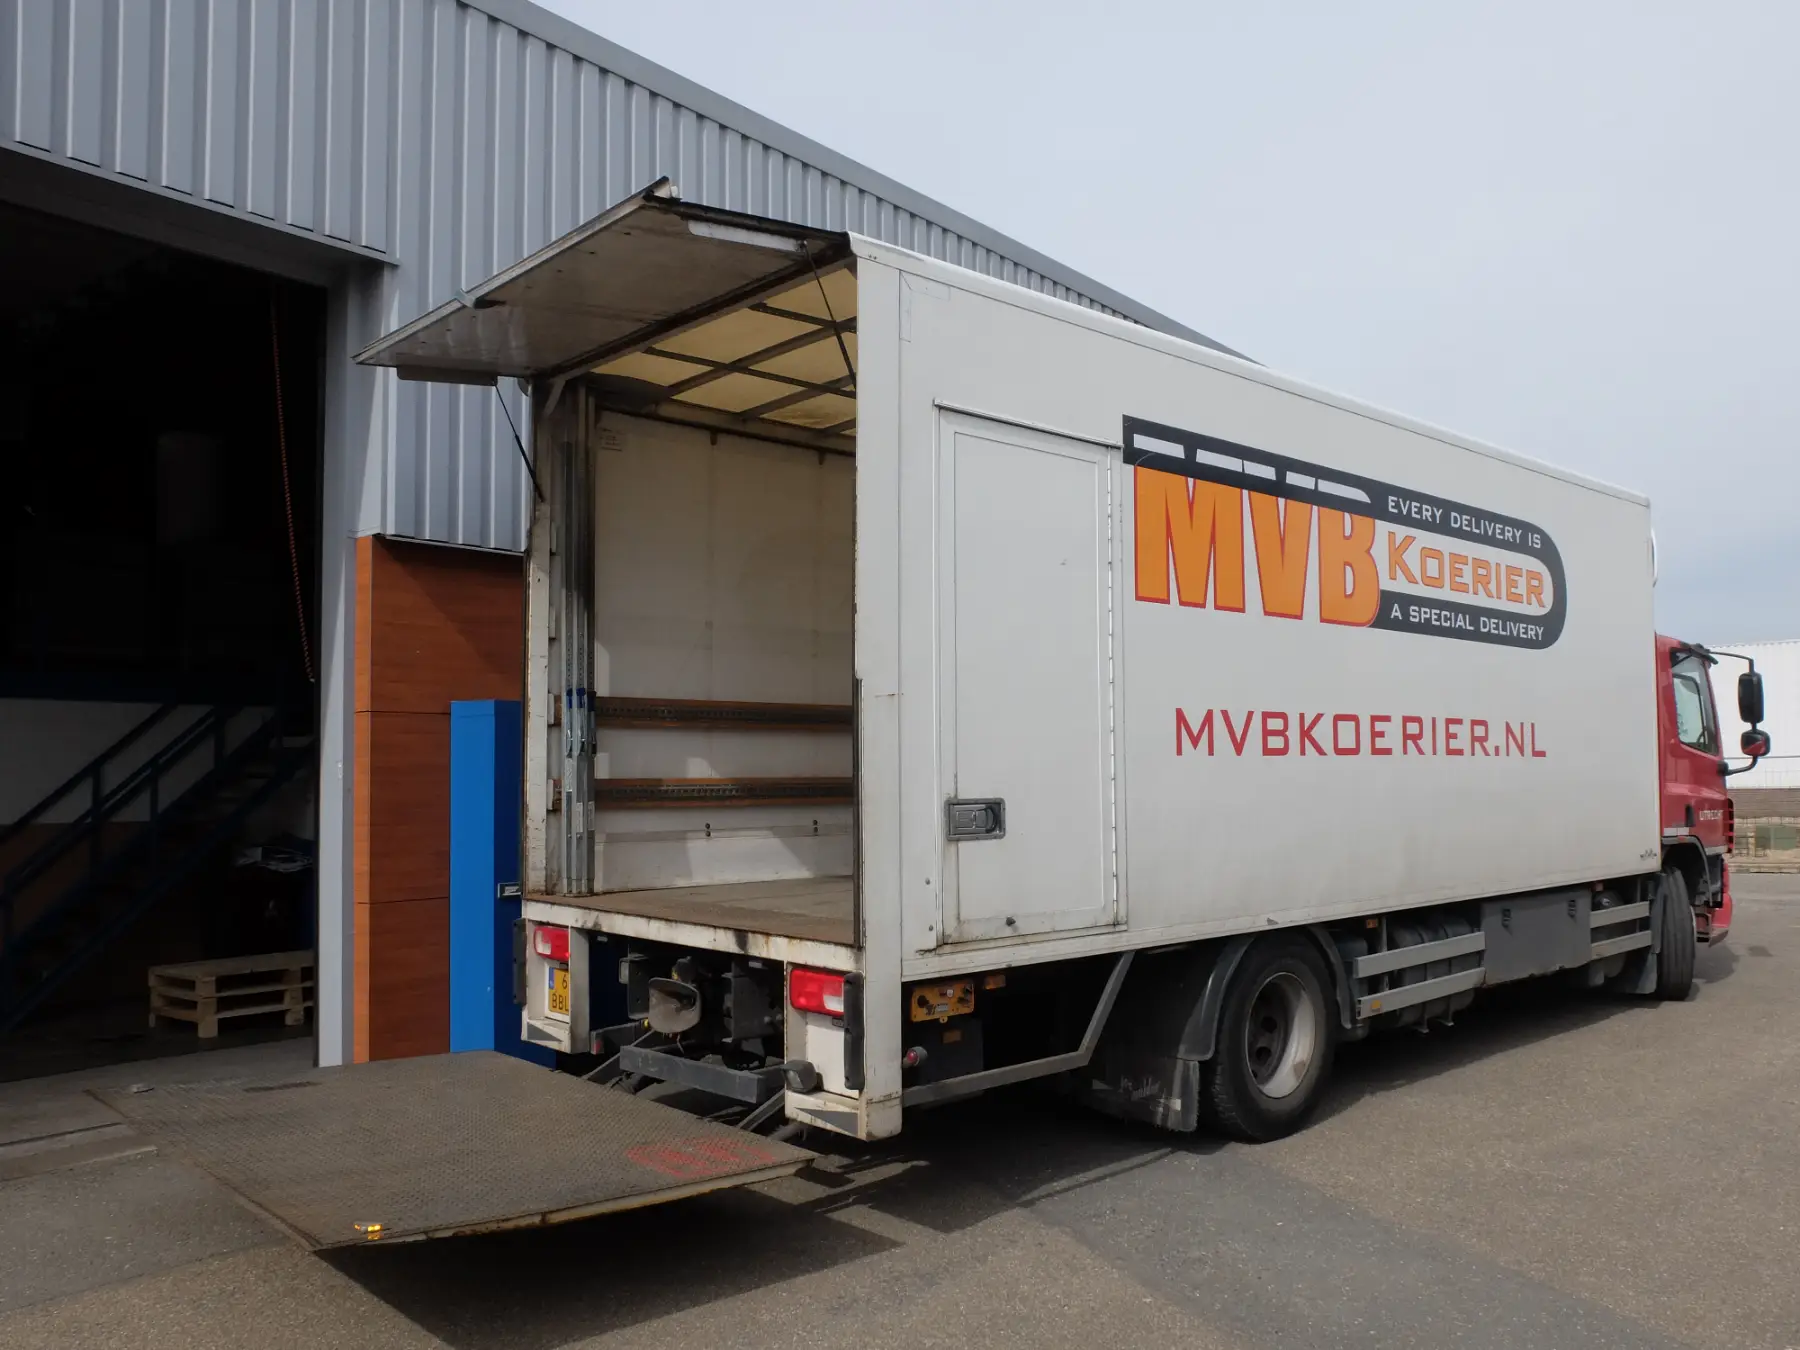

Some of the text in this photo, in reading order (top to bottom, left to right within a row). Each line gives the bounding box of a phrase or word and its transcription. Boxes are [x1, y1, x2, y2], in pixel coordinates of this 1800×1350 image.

[1133, 464, 1380, 628] MVB
[1388, 495, 1542, 549] EVERY DELIVERY IS
[1387, 530, 1546, 608] KOERIER
[1390, 603, 1544, 641] A SPECIAL DELIVERY
[1175, 707, 1547, 758] MVBKOERIER.NL
